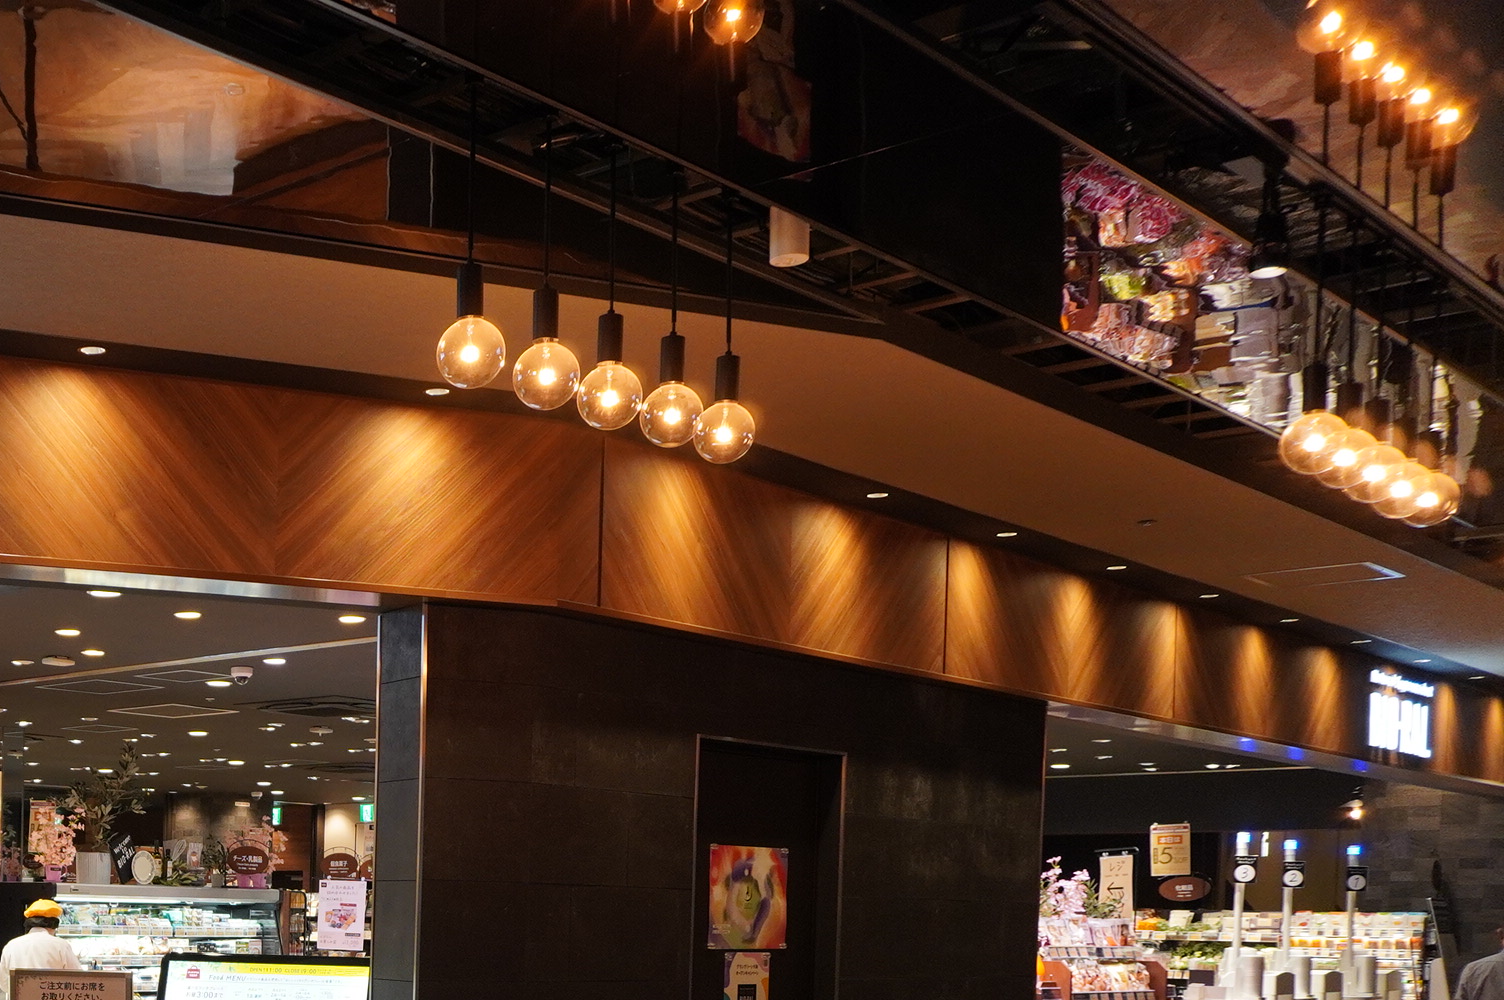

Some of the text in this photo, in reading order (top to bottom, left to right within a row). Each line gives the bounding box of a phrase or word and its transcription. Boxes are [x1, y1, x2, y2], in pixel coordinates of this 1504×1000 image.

[1241, 867, 1248, 879] 3
[1289, 873, 1298, 883] 2
[39, 981, 105, 991] ご注文前にお席を
